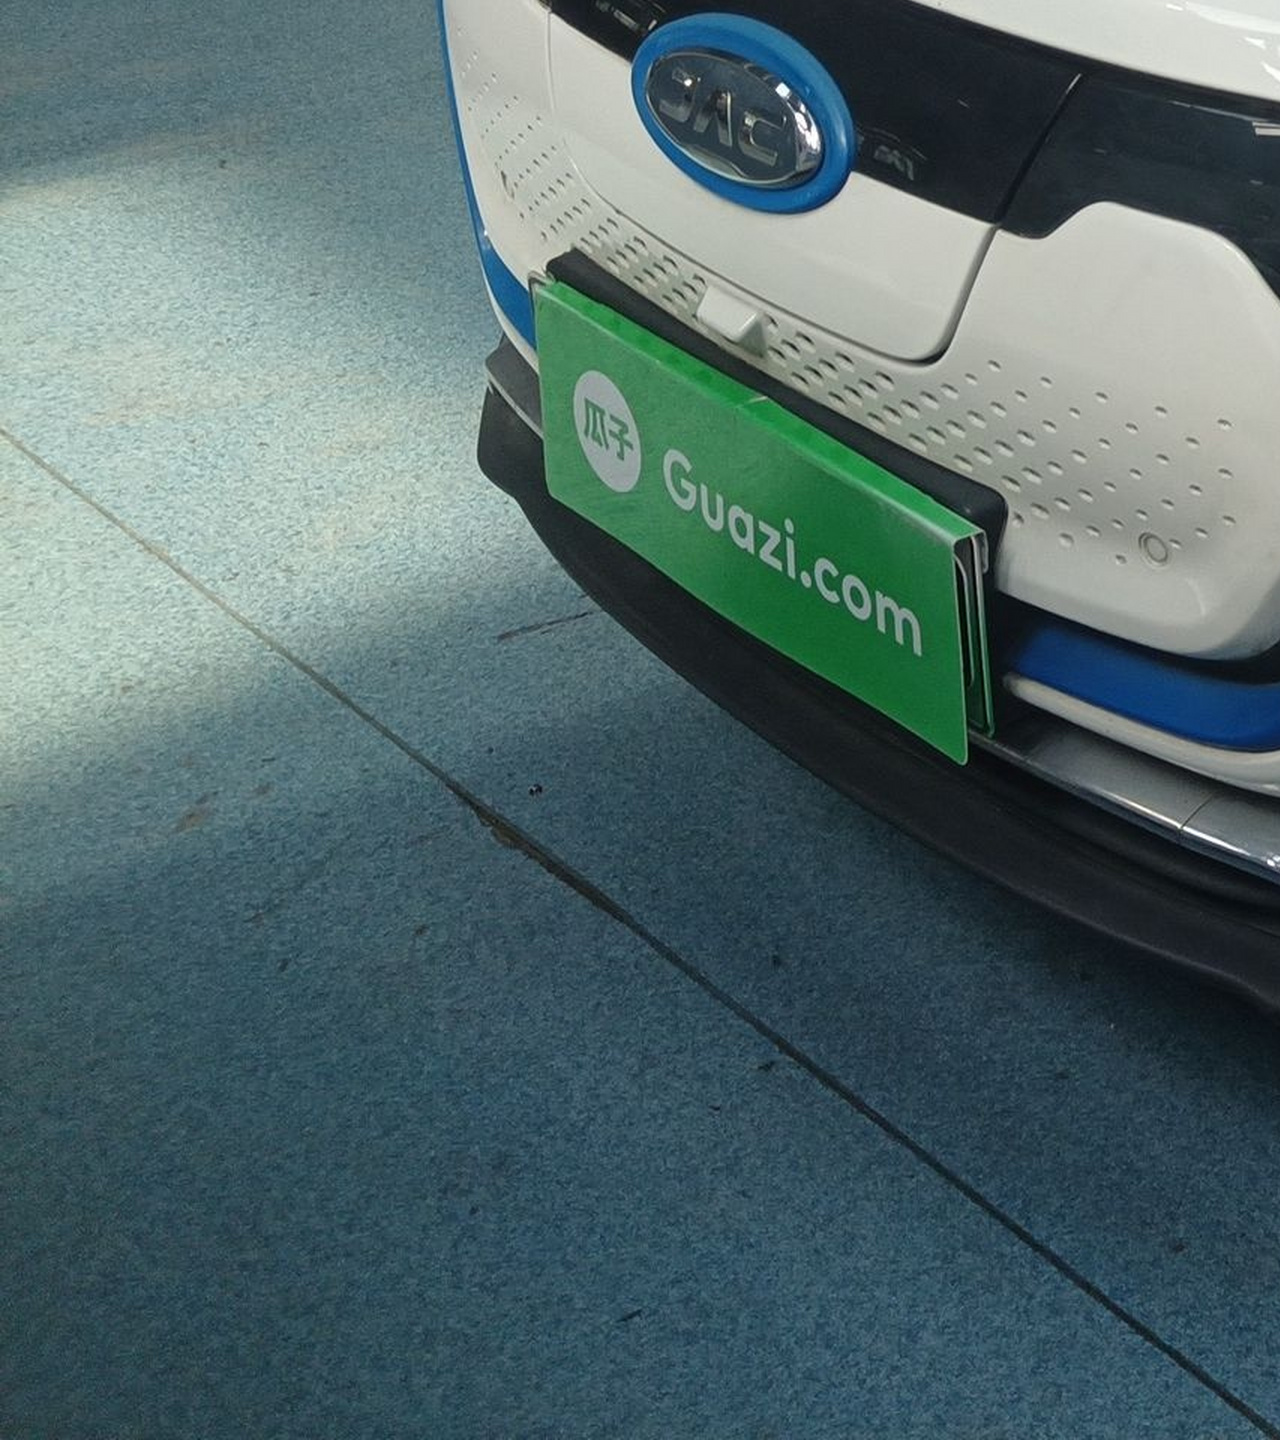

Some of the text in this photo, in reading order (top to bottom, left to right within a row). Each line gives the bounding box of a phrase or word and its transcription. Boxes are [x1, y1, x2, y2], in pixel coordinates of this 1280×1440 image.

[657, 66, 788, 167] JAC
[582, 396, 635, 461] 瓜子
[662, 448, 923, 658] Guazi.com
